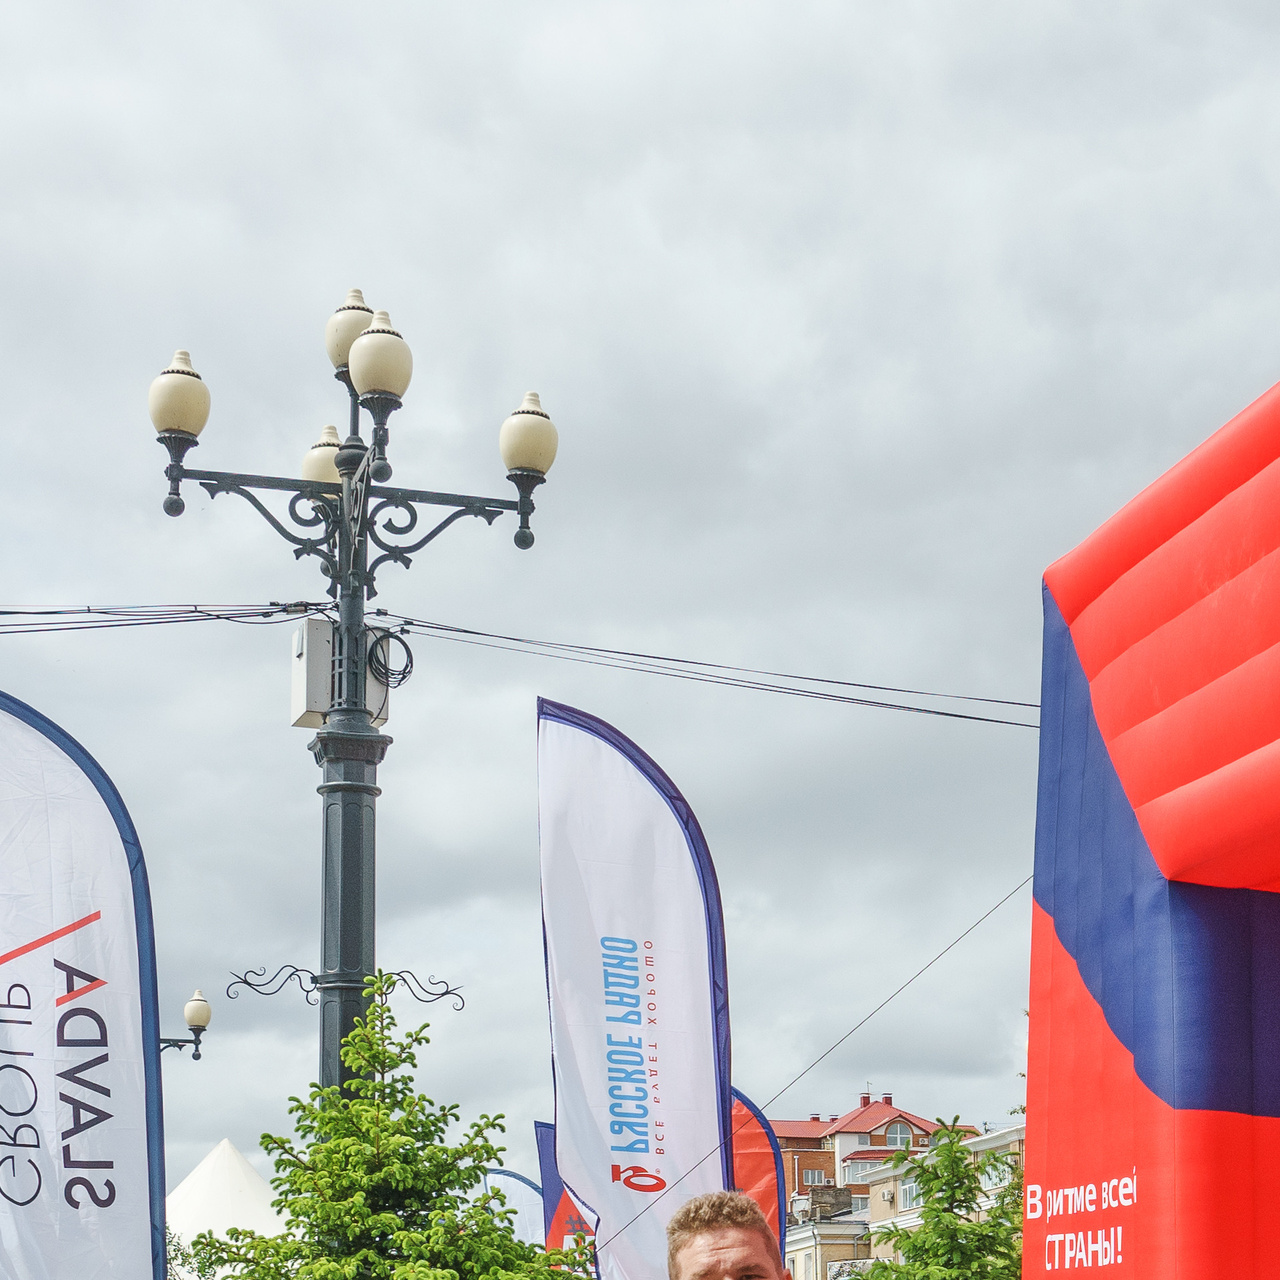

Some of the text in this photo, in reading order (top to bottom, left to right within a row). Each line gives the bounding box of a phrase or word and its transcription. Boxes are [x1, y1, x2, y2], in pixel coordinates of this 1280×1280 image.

[1026, 1184, 1043, 1220] В
[1046, 1183, 1096, 1224] ритме
[1045, 1226, 1123, 1271] СТРАНЫ!
